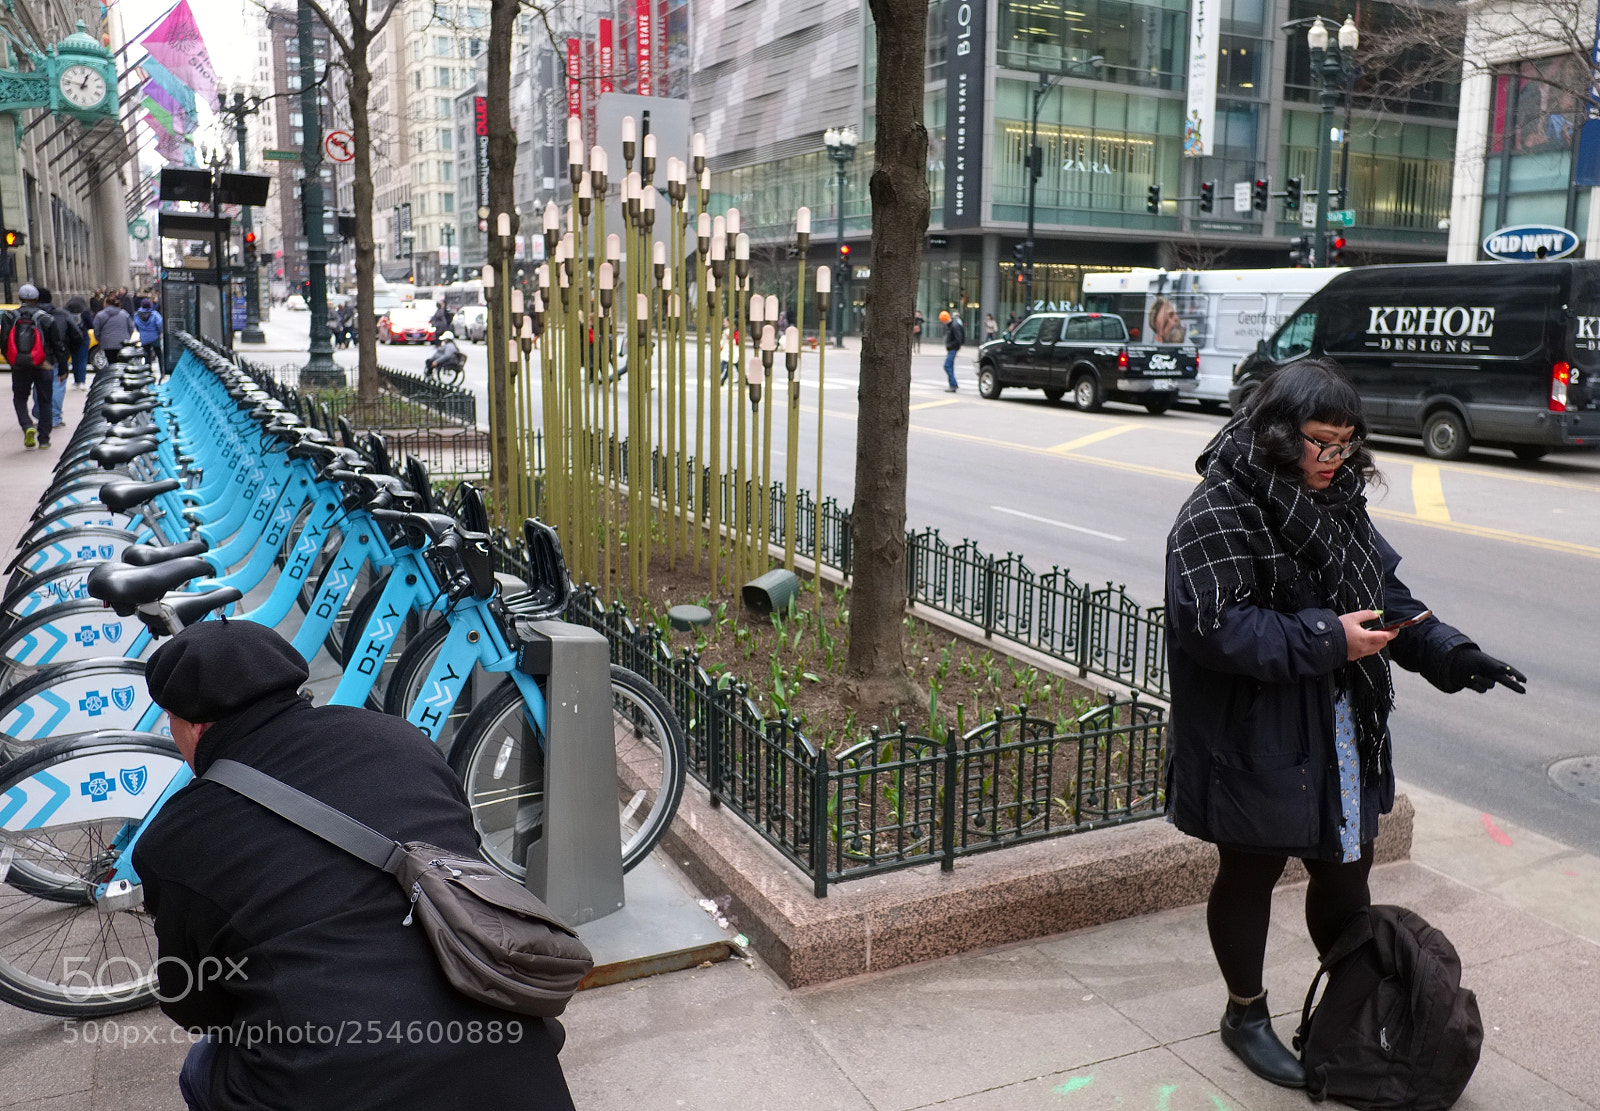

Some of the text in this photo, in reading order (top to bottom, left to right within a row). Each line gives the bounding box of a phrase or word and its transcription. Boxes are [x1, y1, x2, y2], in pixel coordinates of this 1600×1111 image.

[957, 0, 972, 56] BLO
[958, 73, 968, 112] STATE
[958, 116, 966, 124] N
[957, 156, 965, 170] AT
[1063, 159, 1112, 174] ZARA
[956, 175, 965, 215] SHOPS
[1490, 234, 1565, 253] OLD NAVY
[1034, 300, 1085, 311] ZARA
[1366, 306, 1495, 337] KEHOE
[1149, 354, 1177, 370] Ford
[1381, 338, 1471, 352] DESIGNS
[1570, 368, 1580, 384] 2
[243, 459, 268, 501] DIVVY
[253, 477, 281, 522] DIVVY
[266, 497, 296, 547] DIVVY
[289, 524, 322, 581] DIVVY
[315, 557, 354, 620] DIVVY
[357, 603, 400, 676] DIVVY
